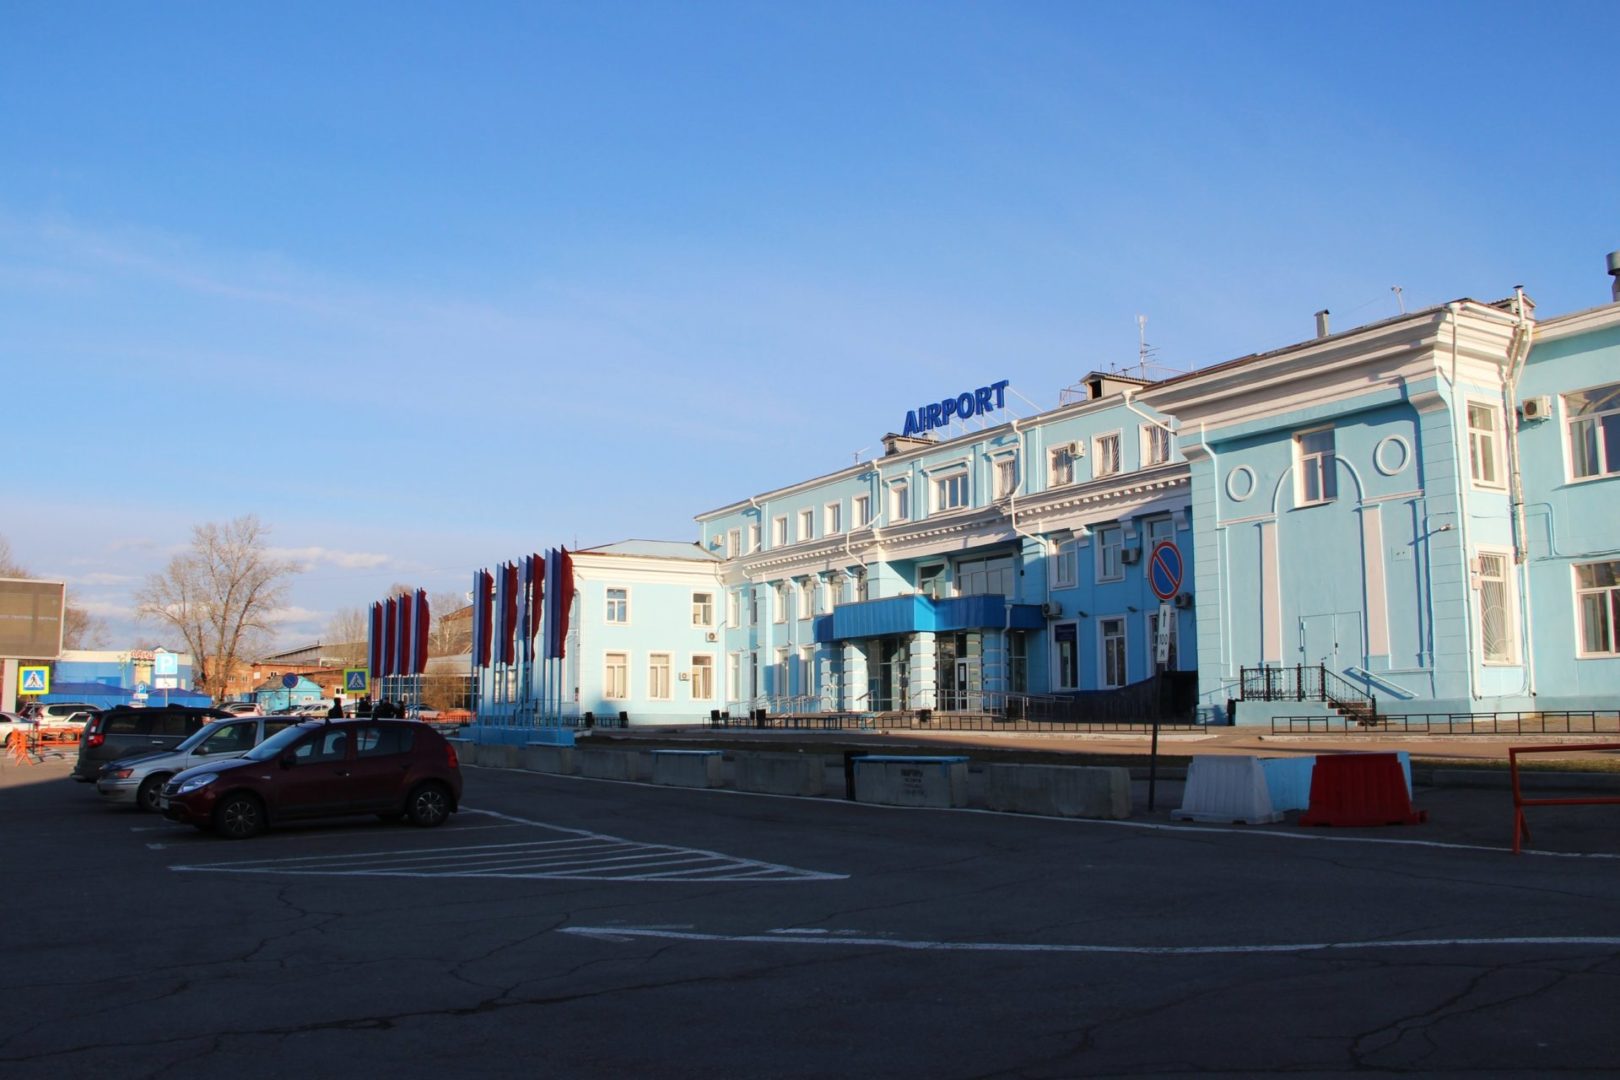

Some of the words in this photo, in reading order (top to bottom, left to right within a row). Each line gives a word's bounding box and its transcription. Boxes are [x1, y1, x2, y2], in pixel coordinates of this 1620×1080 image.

[903, 379, 1009, 437] AIRPORT
[1159, 633, 1168, 645] 100
[160, 655, 173, 672] P
